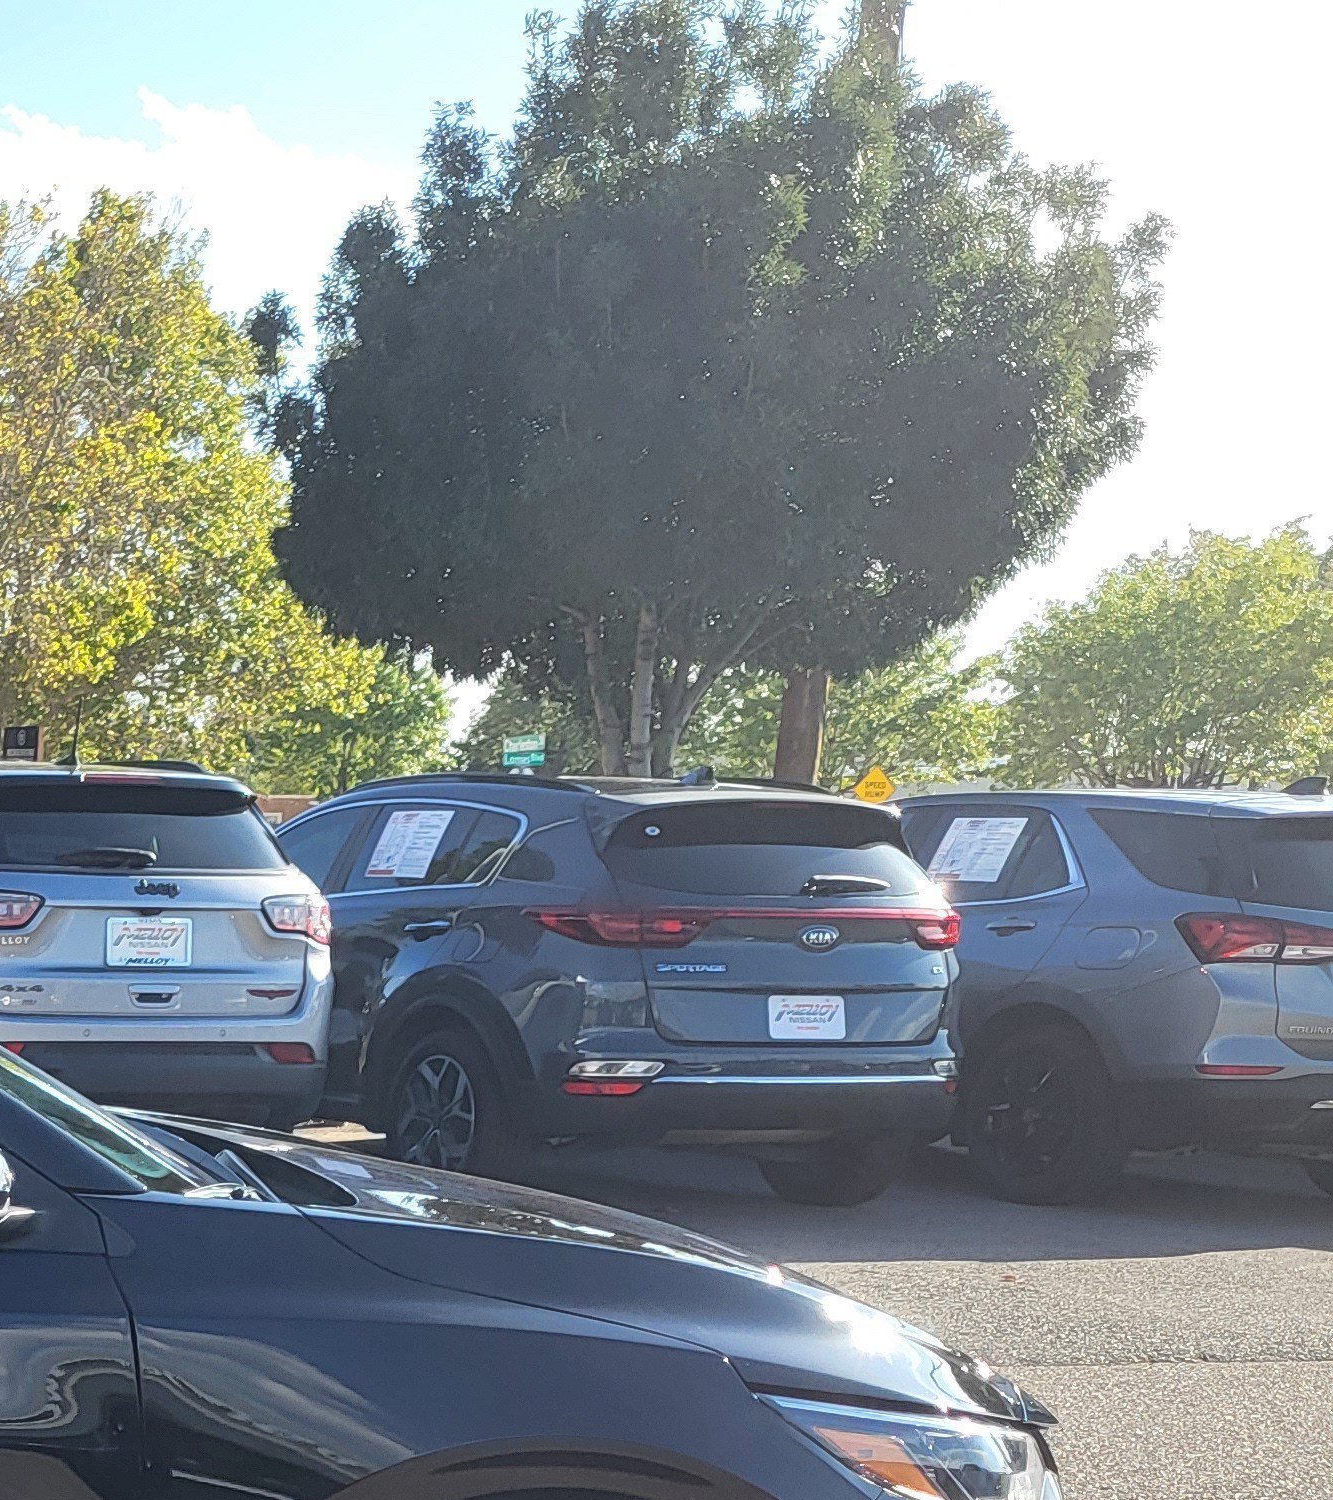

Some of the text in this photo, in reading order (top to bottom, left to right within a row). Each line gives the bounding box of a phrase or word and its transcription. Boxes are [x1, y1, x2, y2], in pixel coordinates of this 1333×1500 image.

[134, 879, 181, 899] Jeep
[113, 926, 185, 946] MELLOY
[809, 932, 832, 944] KIA
[126, 957, 171, 965] MELLOY
[656, 963, 727, 973] SPORTAGE
